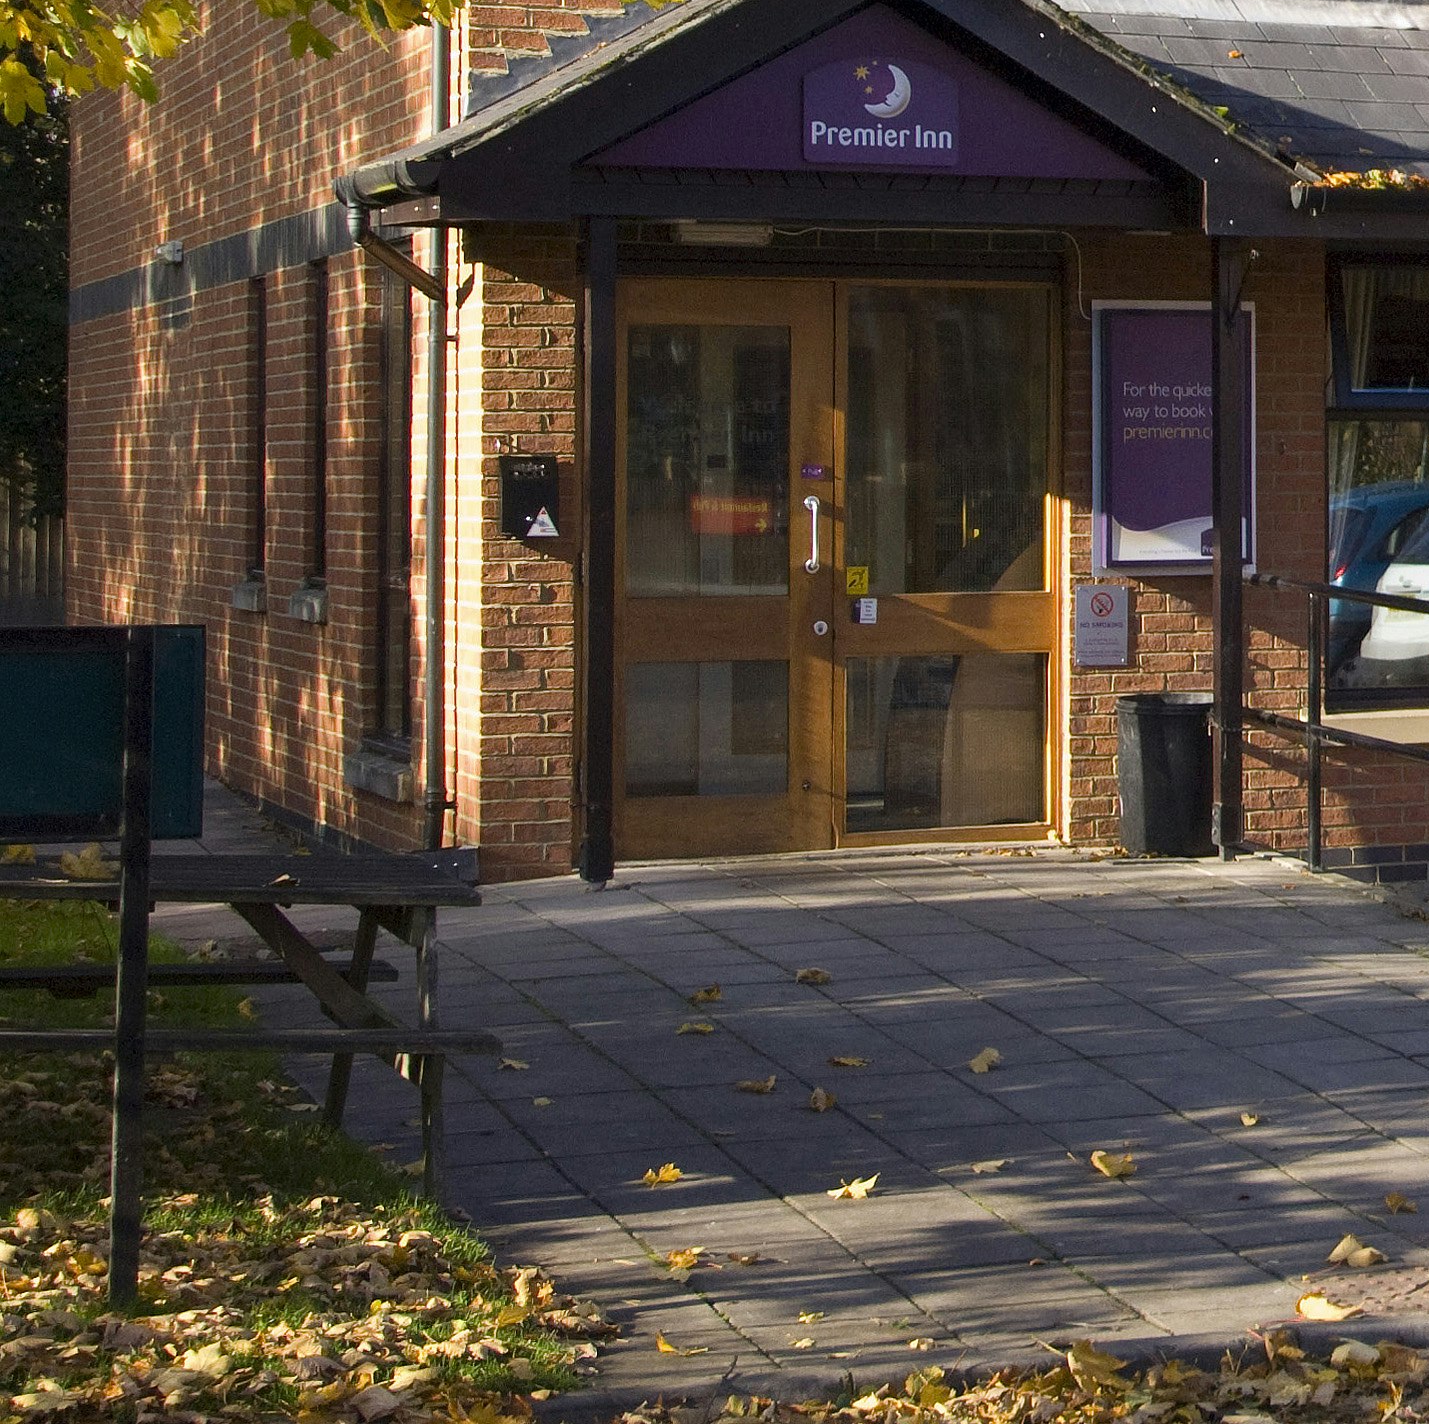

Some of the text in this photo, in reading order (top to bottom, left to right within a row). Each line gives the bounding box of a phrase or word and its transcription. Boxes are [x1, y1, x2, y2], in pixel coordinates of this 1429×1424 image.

[811, 121, 952, 149] Premier Inn
[1123, 381, 1212, 402] For the quicke
[1122, 407, 1150, 422] way
[1154, 405, 1169, 418] to
[1171, 403, 1206, 418] book
[1123, 421, 1213, 444] premierinn.c
